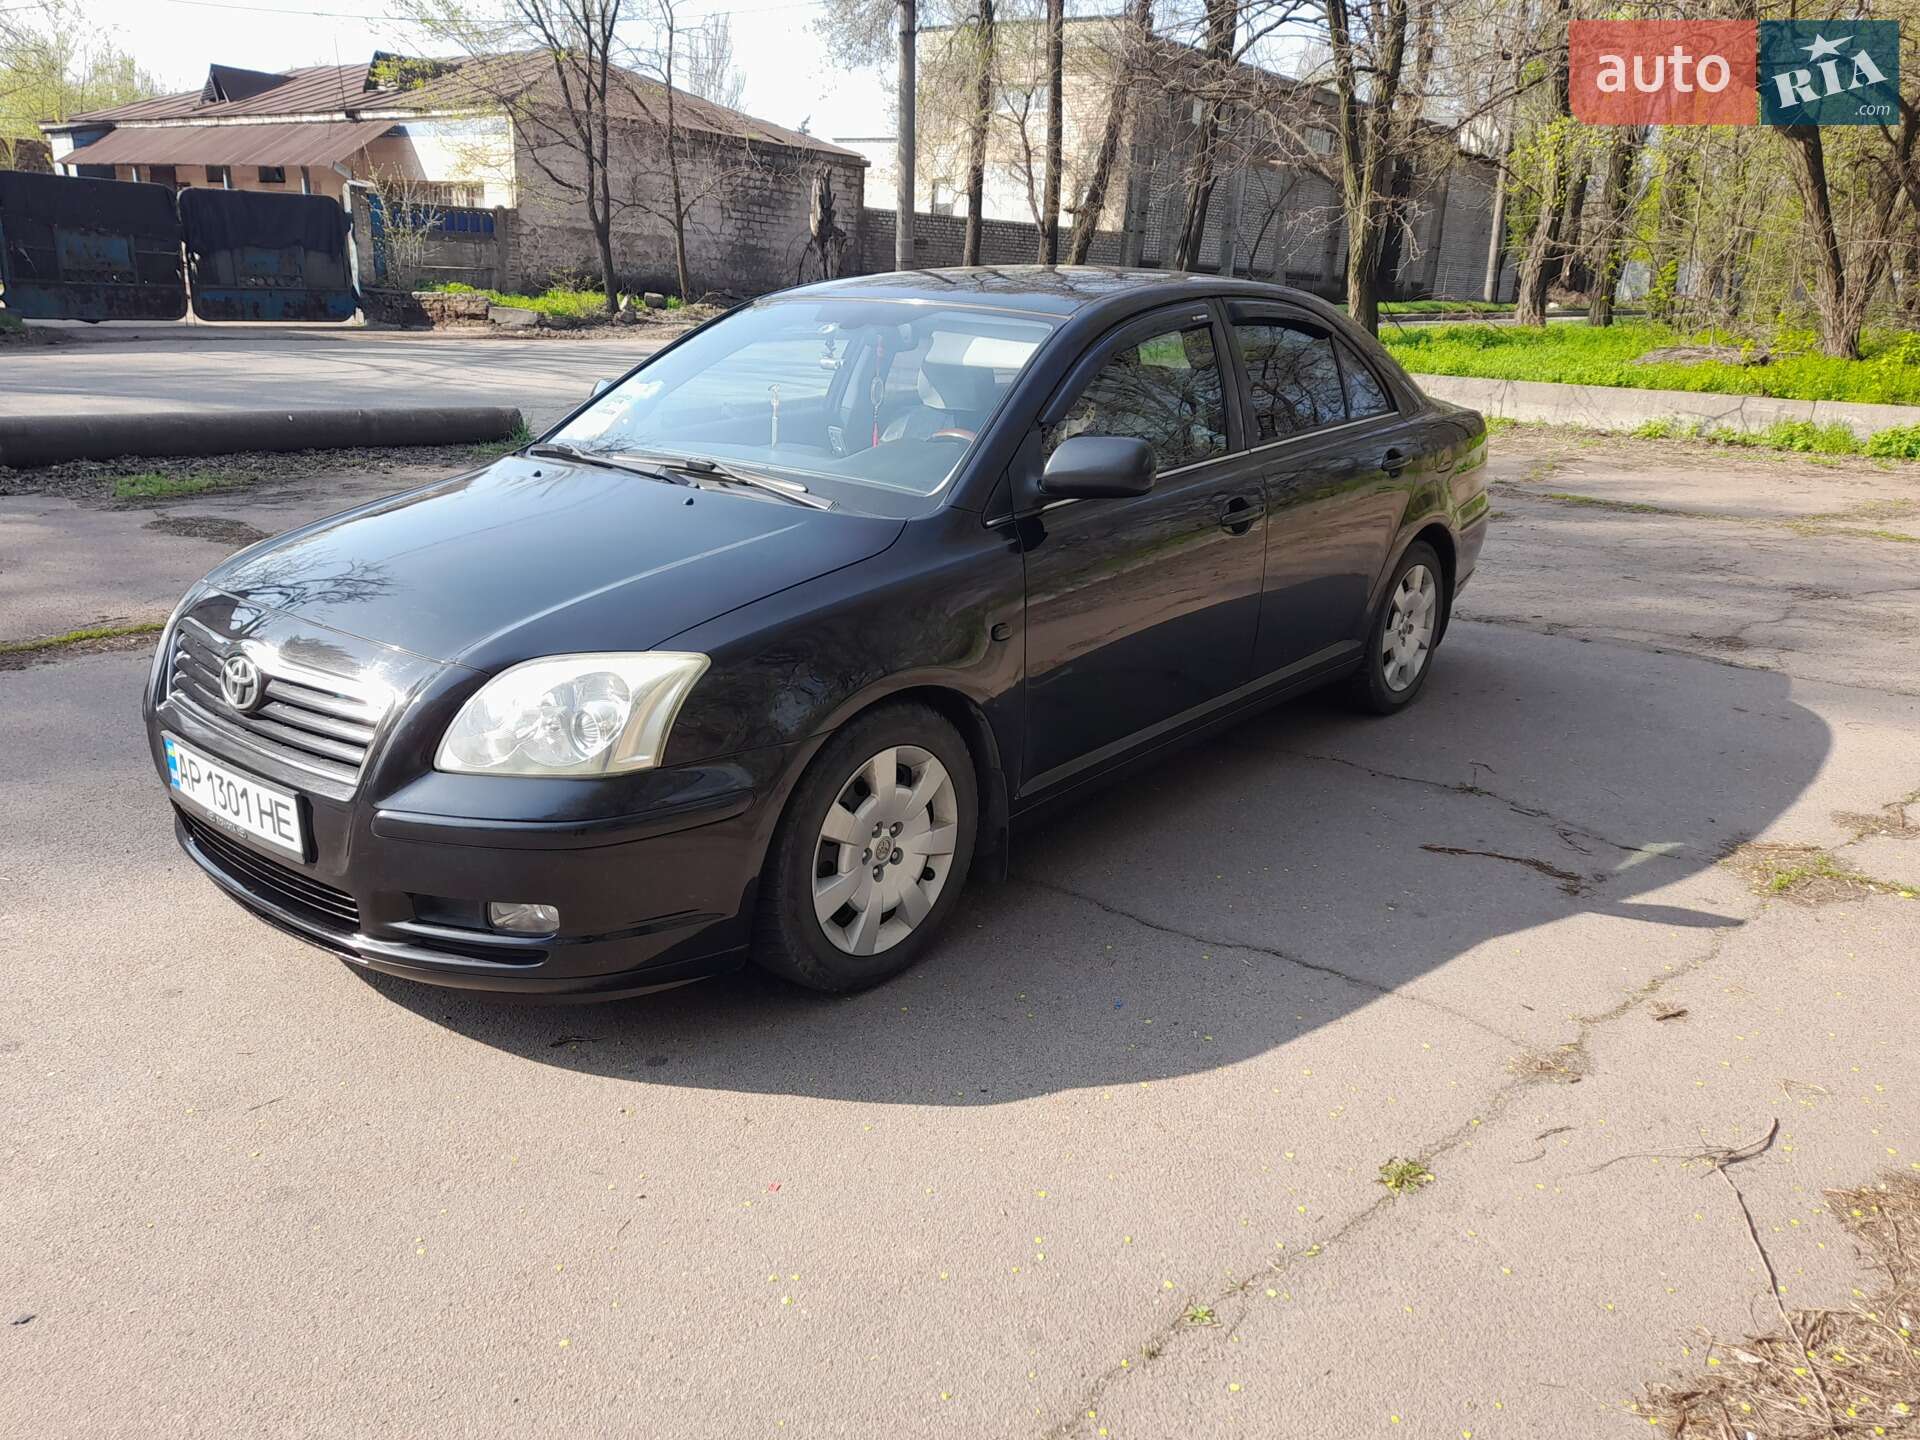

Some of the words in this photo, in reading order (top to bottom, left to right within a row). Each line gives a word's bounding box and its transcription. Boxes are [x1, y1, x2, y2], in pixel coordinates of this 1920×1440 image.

[179, 754, 201, 793] AP
[206, 770, 252, 823] 1301
[256, 792, 295, 842] HE
